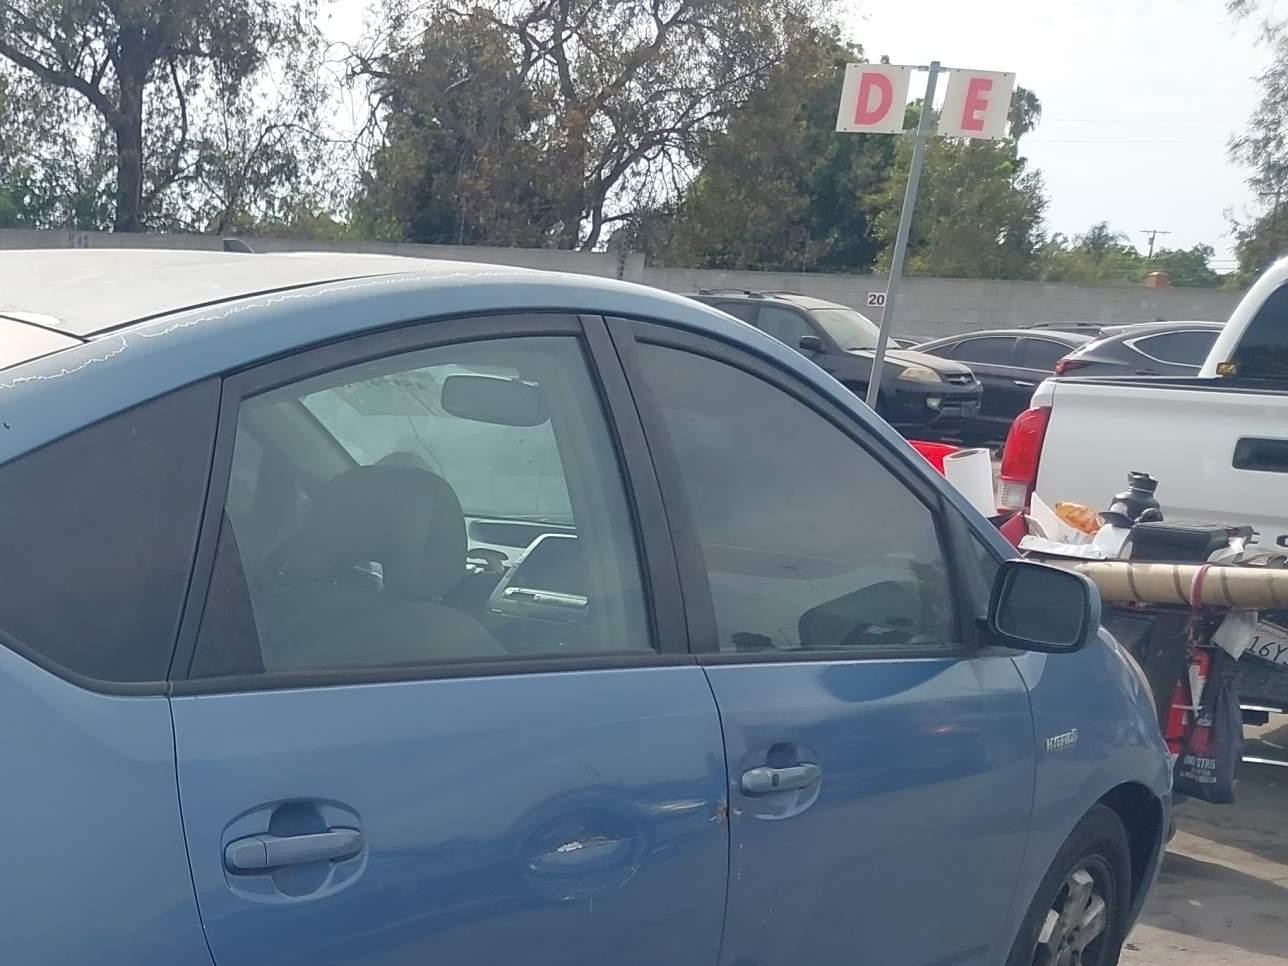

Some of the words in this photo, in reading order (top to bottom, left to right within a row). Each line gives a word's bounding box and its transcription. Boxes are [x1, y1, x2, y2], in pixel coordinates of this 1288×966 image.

[854, 72, 893, 126] D
[960, 77, 993, 132] E
[868, 293, 885, 305] 20
[1244, 635, 1288, 665] 16Y
